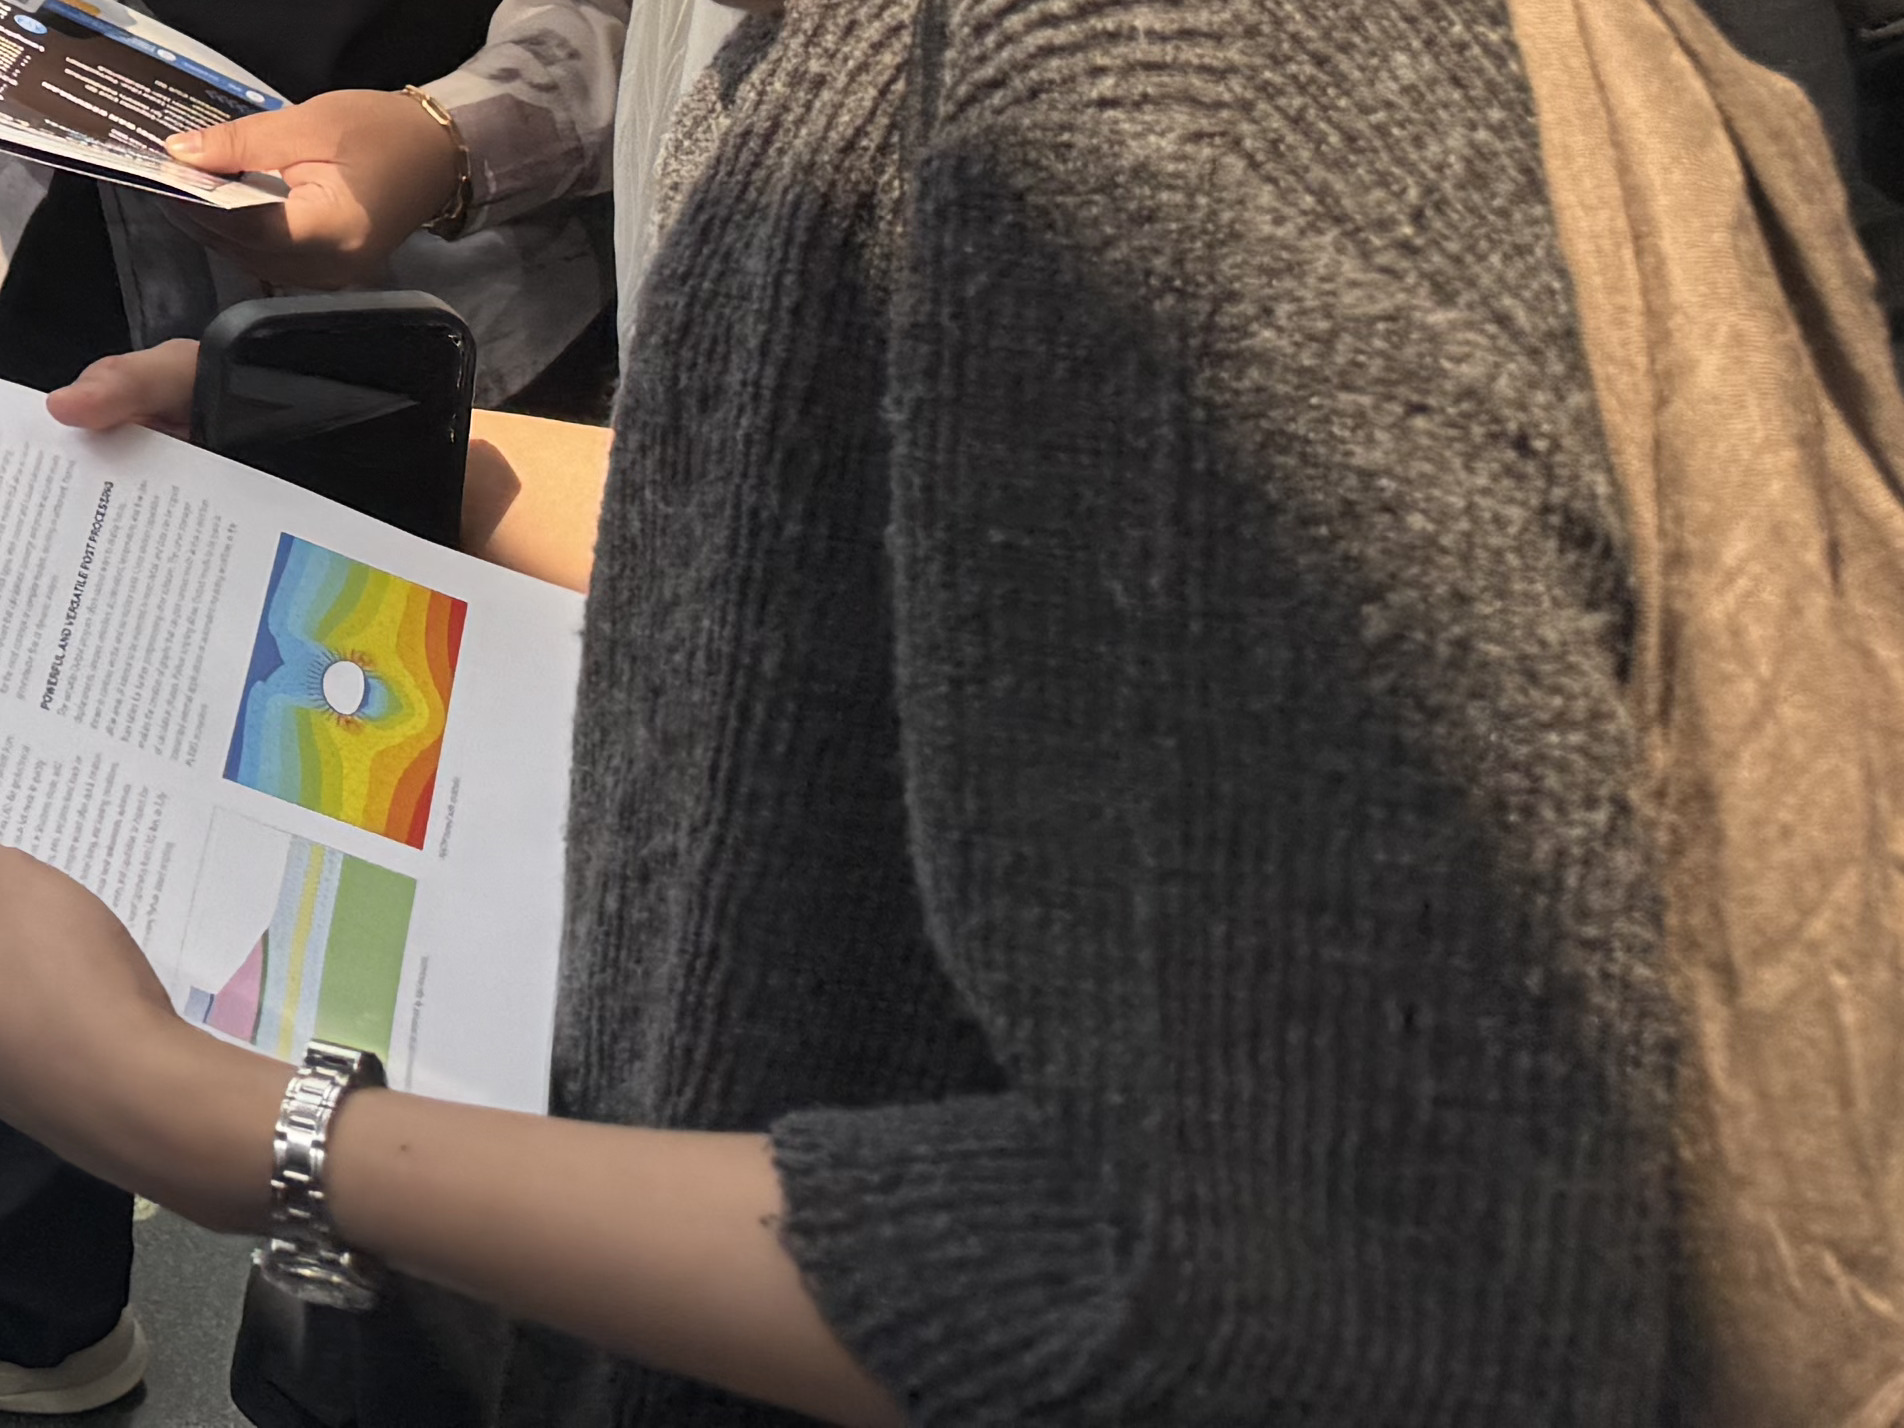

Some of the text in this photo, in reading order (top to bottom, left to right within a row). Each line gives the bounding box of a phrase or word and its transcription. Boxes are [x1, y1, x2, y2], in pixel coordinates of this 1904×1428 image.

[62, 570, 89, 627] VERSATILE
[56, 626, 73, 651] AND
[39, 649, 66, 711] POWERFUL
